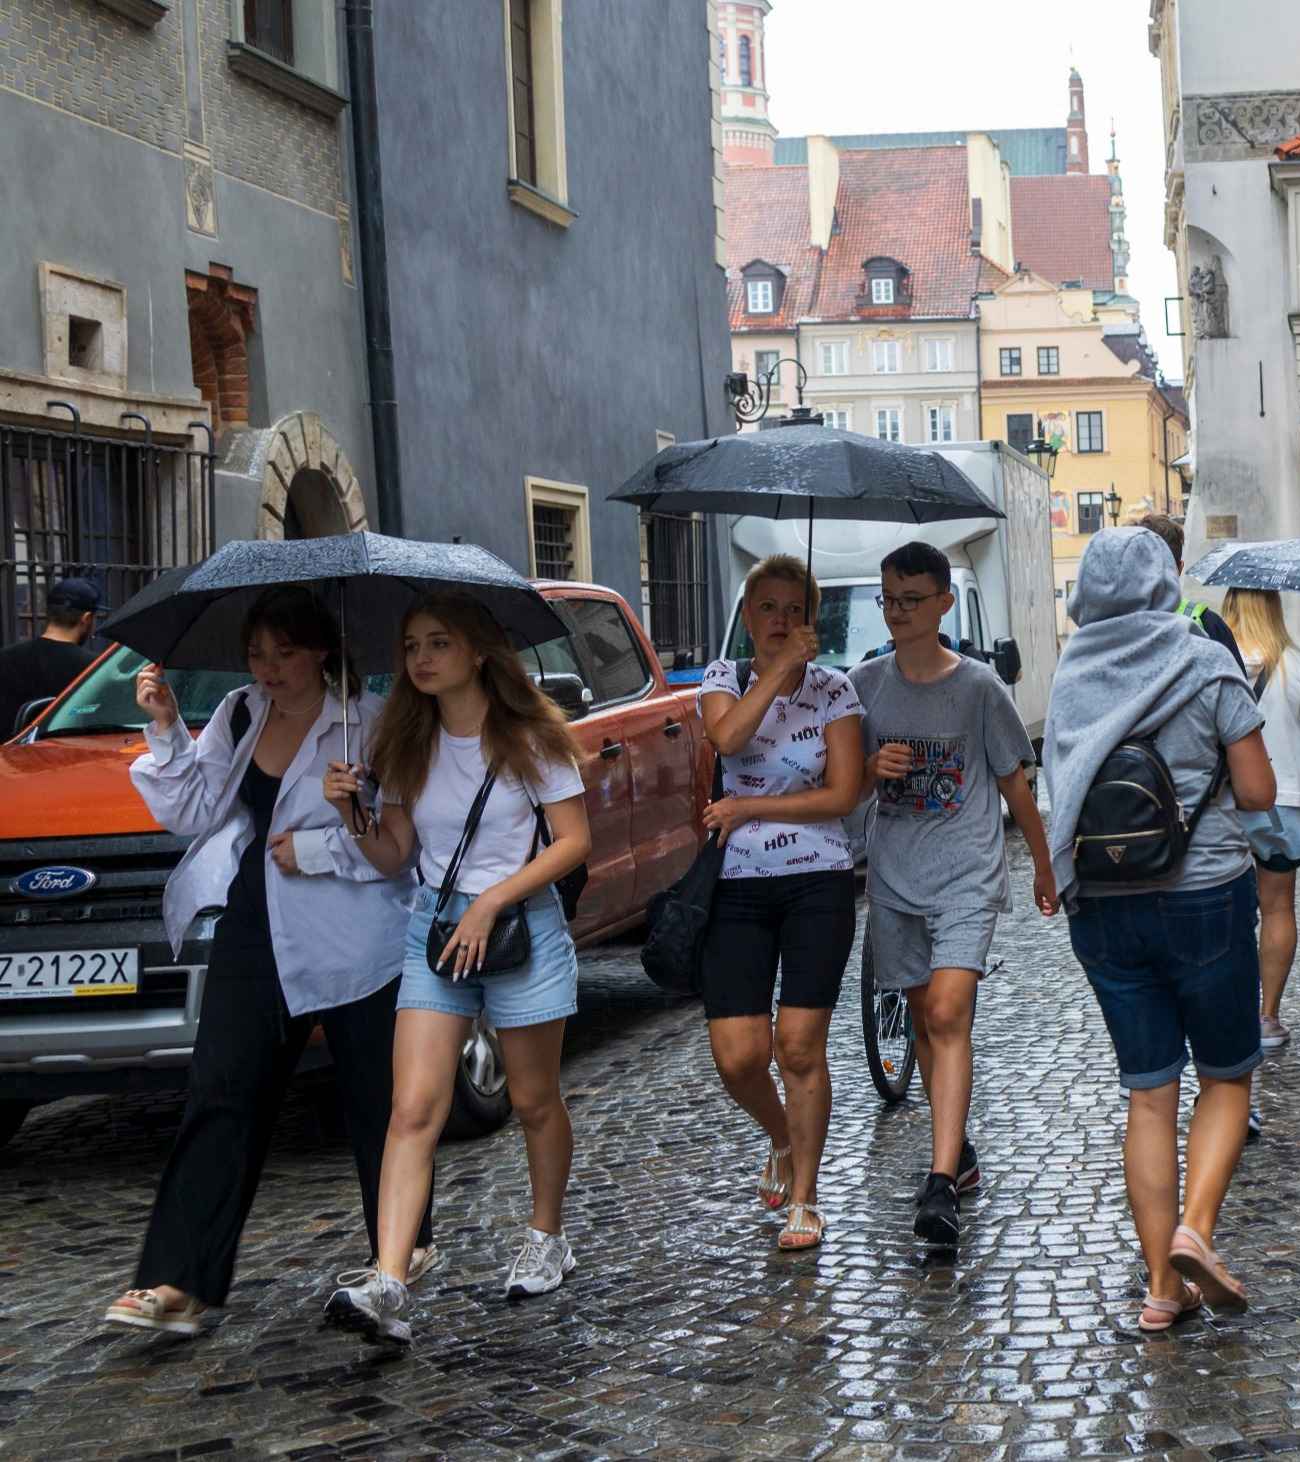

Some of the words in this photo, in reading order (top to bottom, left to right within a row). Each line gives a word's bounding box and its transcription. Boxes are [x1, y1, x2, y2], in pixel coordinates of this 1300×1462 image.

[791, 726, 819, 742] HOT
[764, 832, 799, 851] HOT
[786, 850, 820, 866] enough
[29, 871, 75, 890] Ford
[27, 952, 129, 987] 2122X
